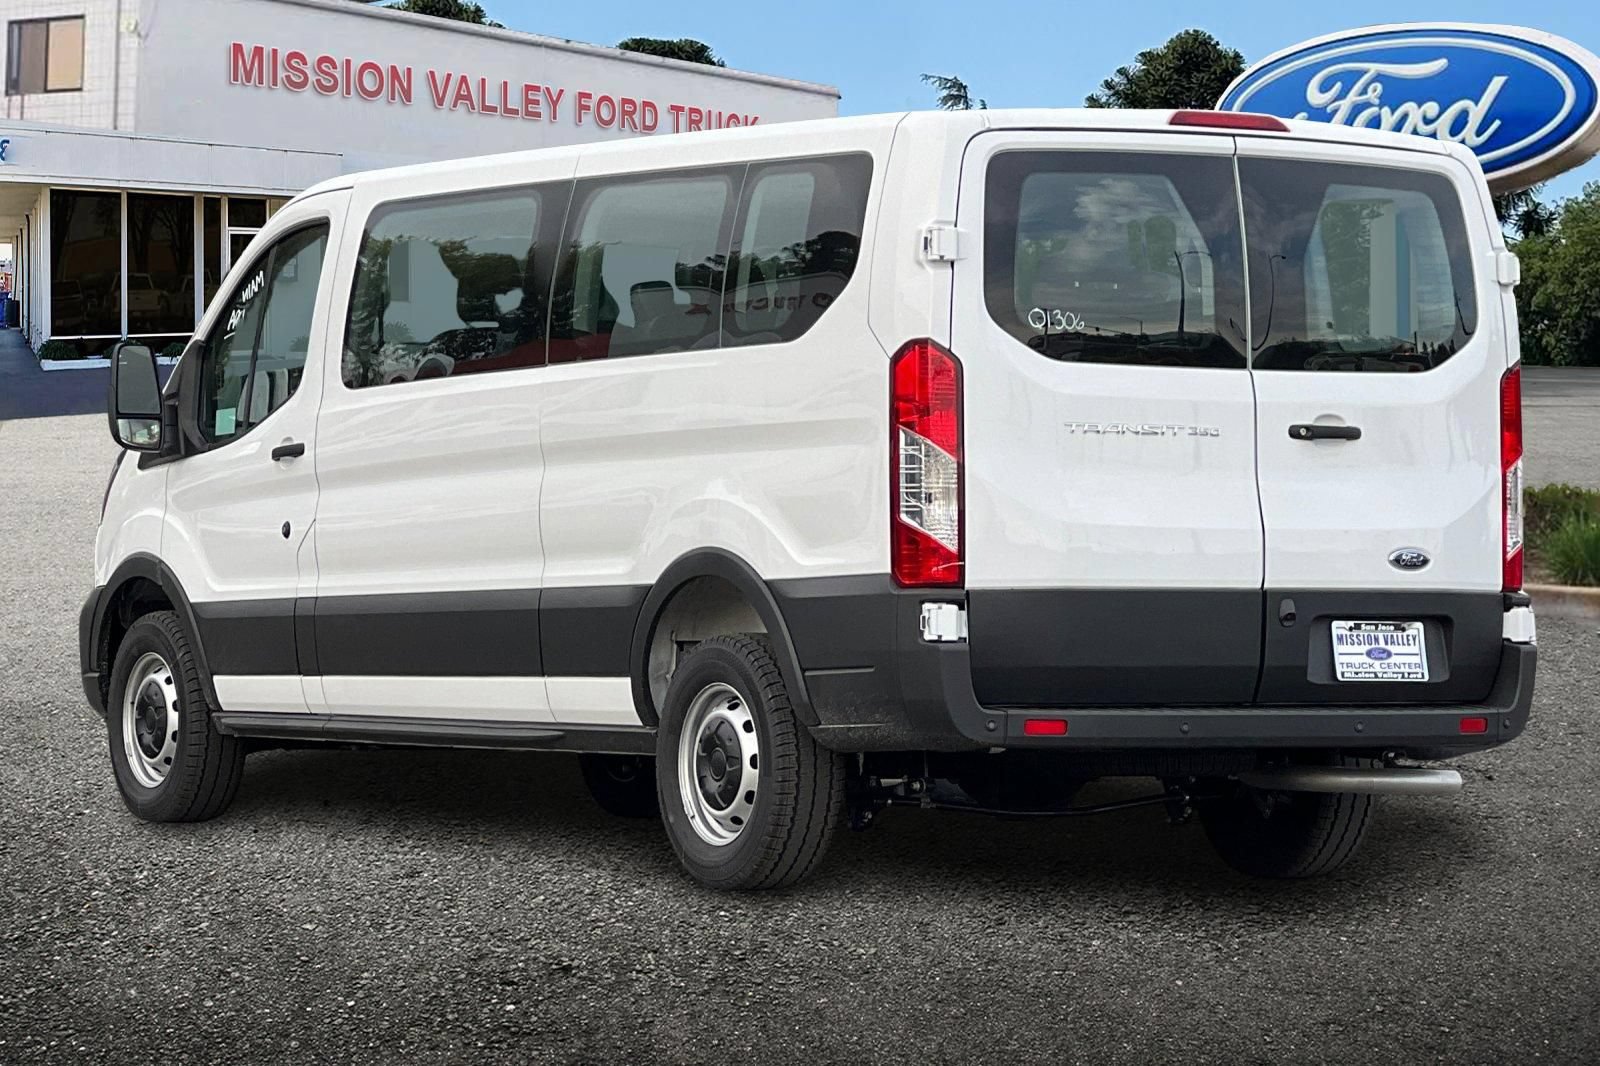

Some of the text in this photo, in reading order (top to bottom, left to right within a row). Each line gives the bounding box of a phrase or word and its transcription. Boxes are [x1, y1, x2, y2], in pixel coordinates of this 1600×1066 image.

[228, 41, 414, 104] MISSION
[426, 69, 566, 123] VALLEY
[575, 91, 660, 135] FORD
[1294, 57, 1509, 148] Ford
[1027, 307, 1085, 330] Q1306
[1064, 421, 1220, 437] TRANSIT 350
[1360, 623, 1376, 631] San
[1336, 633, 1417, 646] MISSION VALLEY
[1370, 649, 1388, 658] Ford
[1340, 662, 1421, 670] TRUCK CENTER
